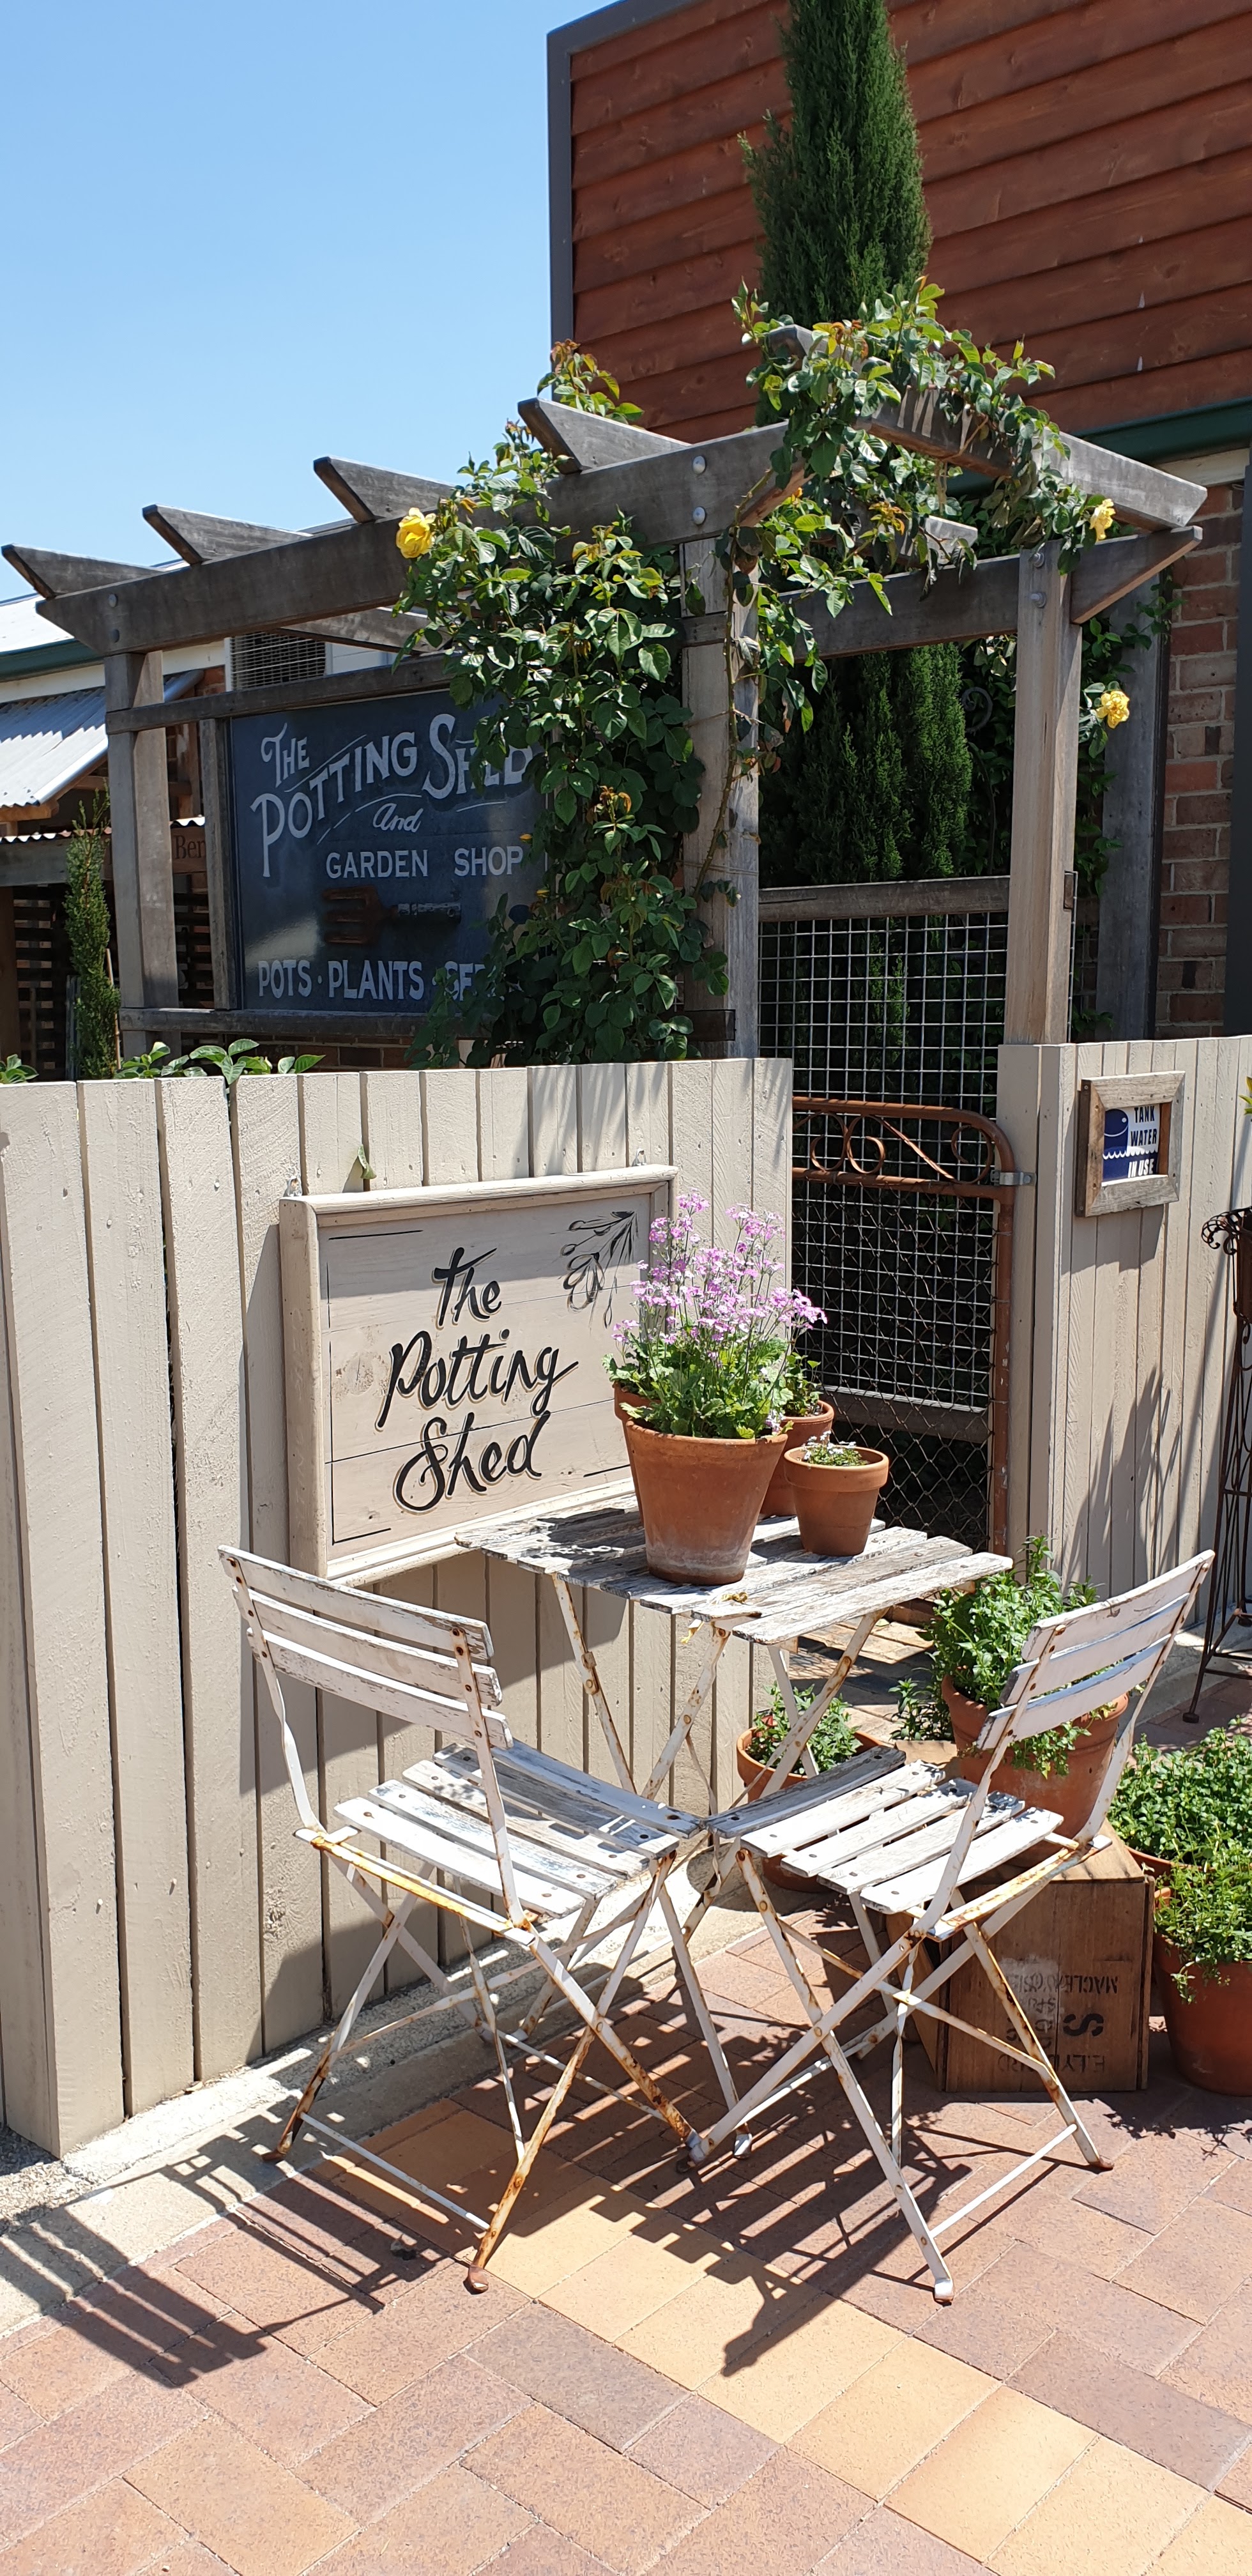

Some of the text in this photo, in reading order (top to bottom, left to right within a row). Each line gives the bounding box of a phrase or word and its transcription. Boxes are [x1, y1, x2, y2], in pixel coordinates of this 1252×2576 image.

[261, 723, 310, 788] THE
[250, 731, 418, 878] POTTING
[373, 803, 424, 832] And
[326, 846, 524, 878] GARDEN SHOP
[258, 960, 312, 999] POTS
[328, 960, 425, 1000] PLANTS
[1134, 1105, 1155, 1123] TANK
[1130, 1128, 1157, 1146] WATER
[1127, 1158, 1154, 1178] IN USE
[375, 1328, 579, 1432] Potting
[392, 1409, 551, 1516] Shed
